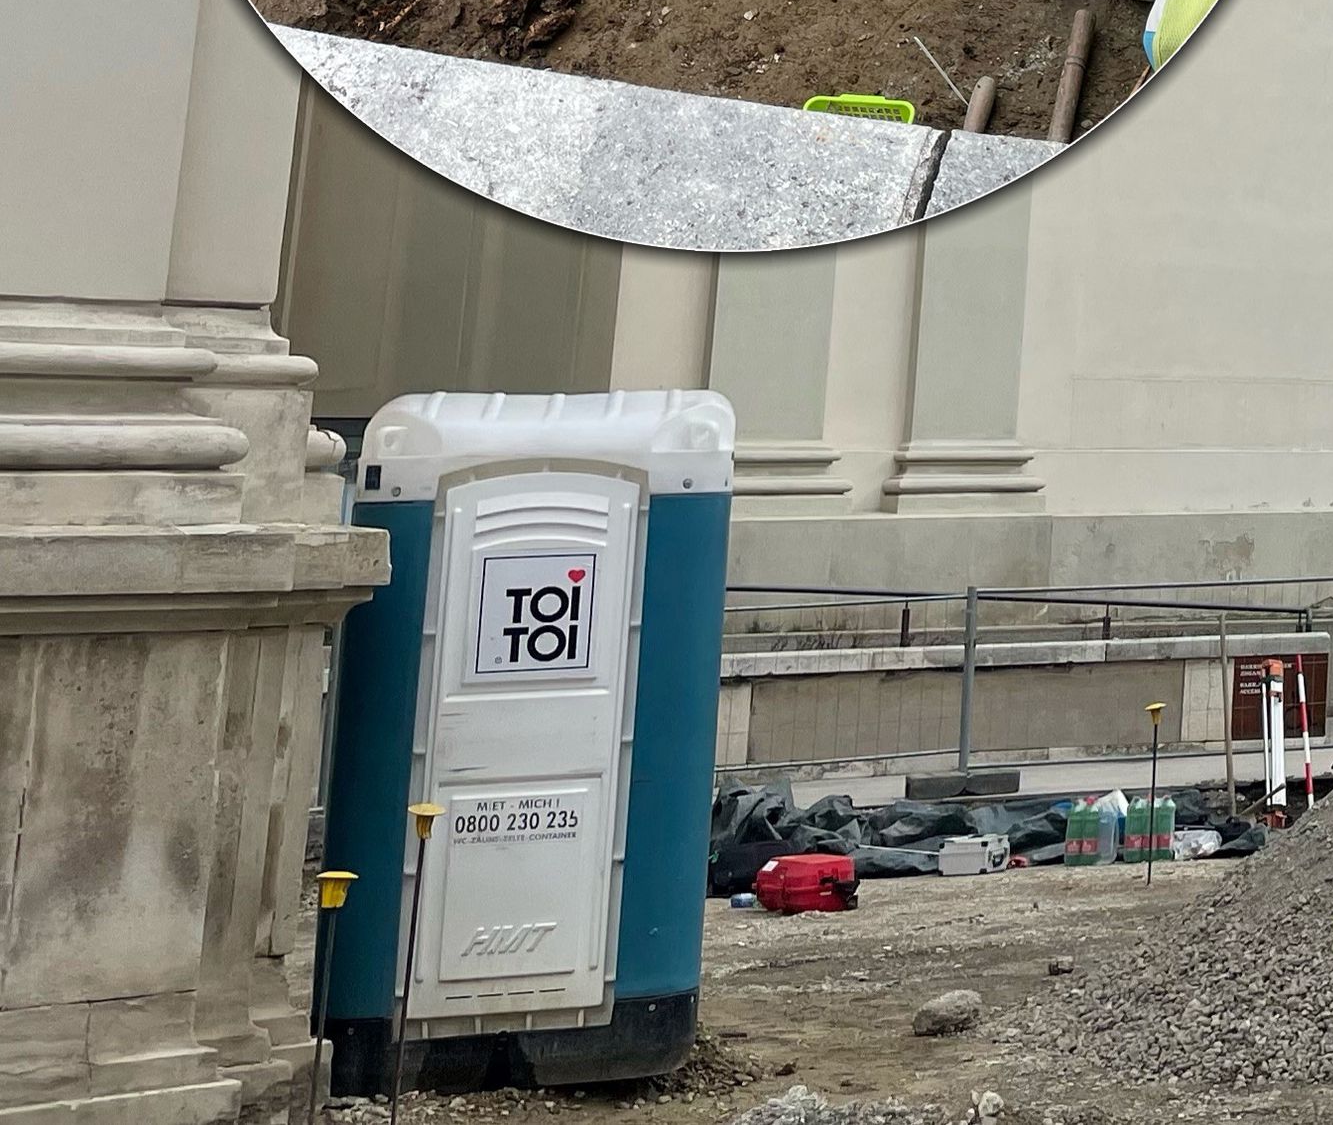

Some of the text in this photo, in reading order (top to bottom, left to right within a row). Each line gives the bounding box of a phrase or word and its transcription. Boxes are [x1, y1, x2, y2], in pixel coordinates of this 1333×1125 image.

[505, 586, 581, 623] TOI
[503, 625, 578, 662] TOI
[455, 810, 578, 834] 0800 230 235
